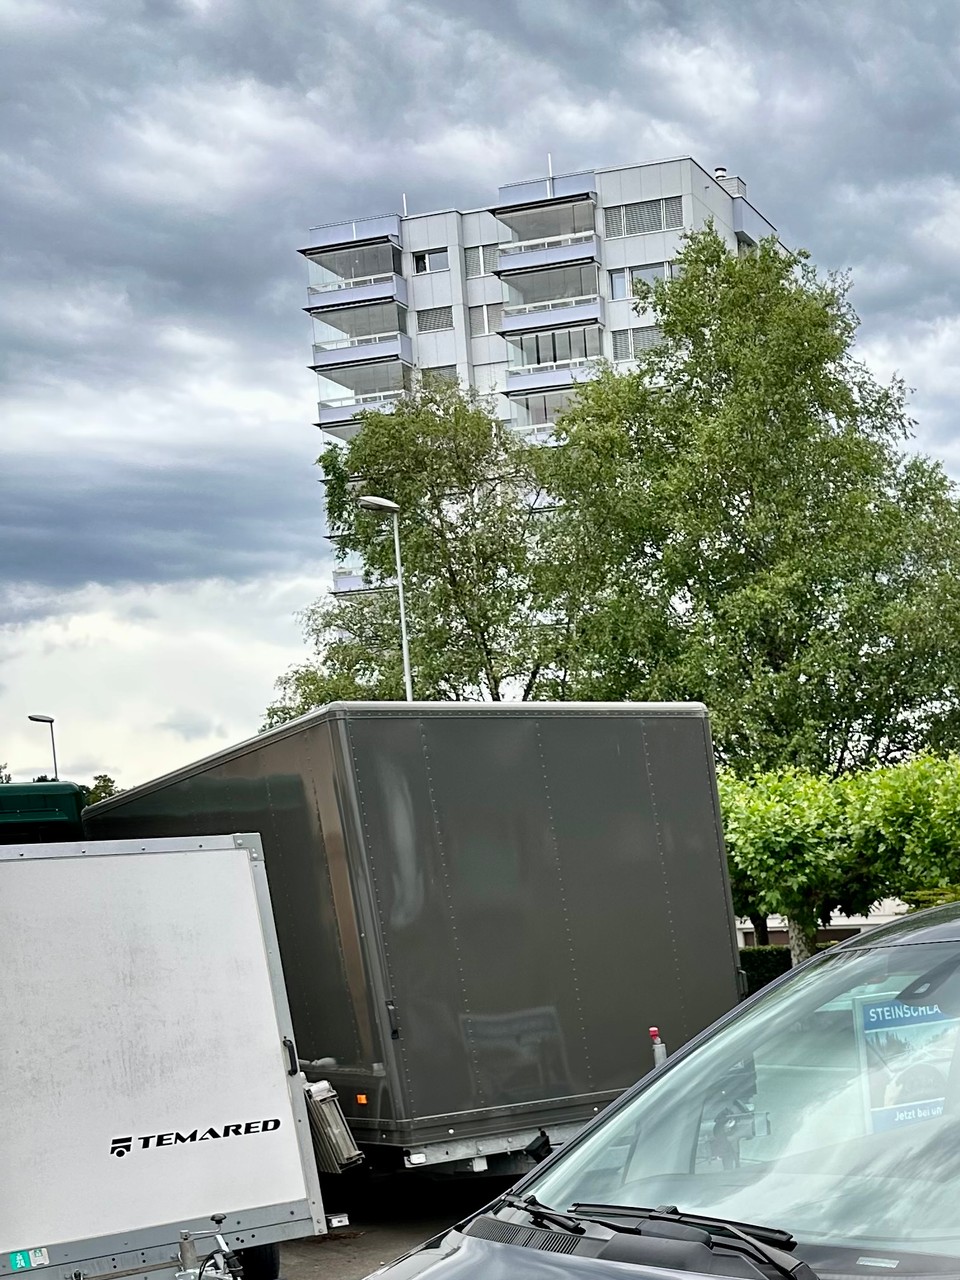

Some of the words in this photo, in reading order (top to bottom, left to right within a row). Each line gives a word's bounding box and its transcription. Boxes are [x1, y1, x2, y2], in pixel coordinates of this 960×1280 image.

[894, 1109, 916, 1122] Jetzt
[917, 1108, 930, 1118] bei
[137, 1118, 281, 1149] TEMARED
